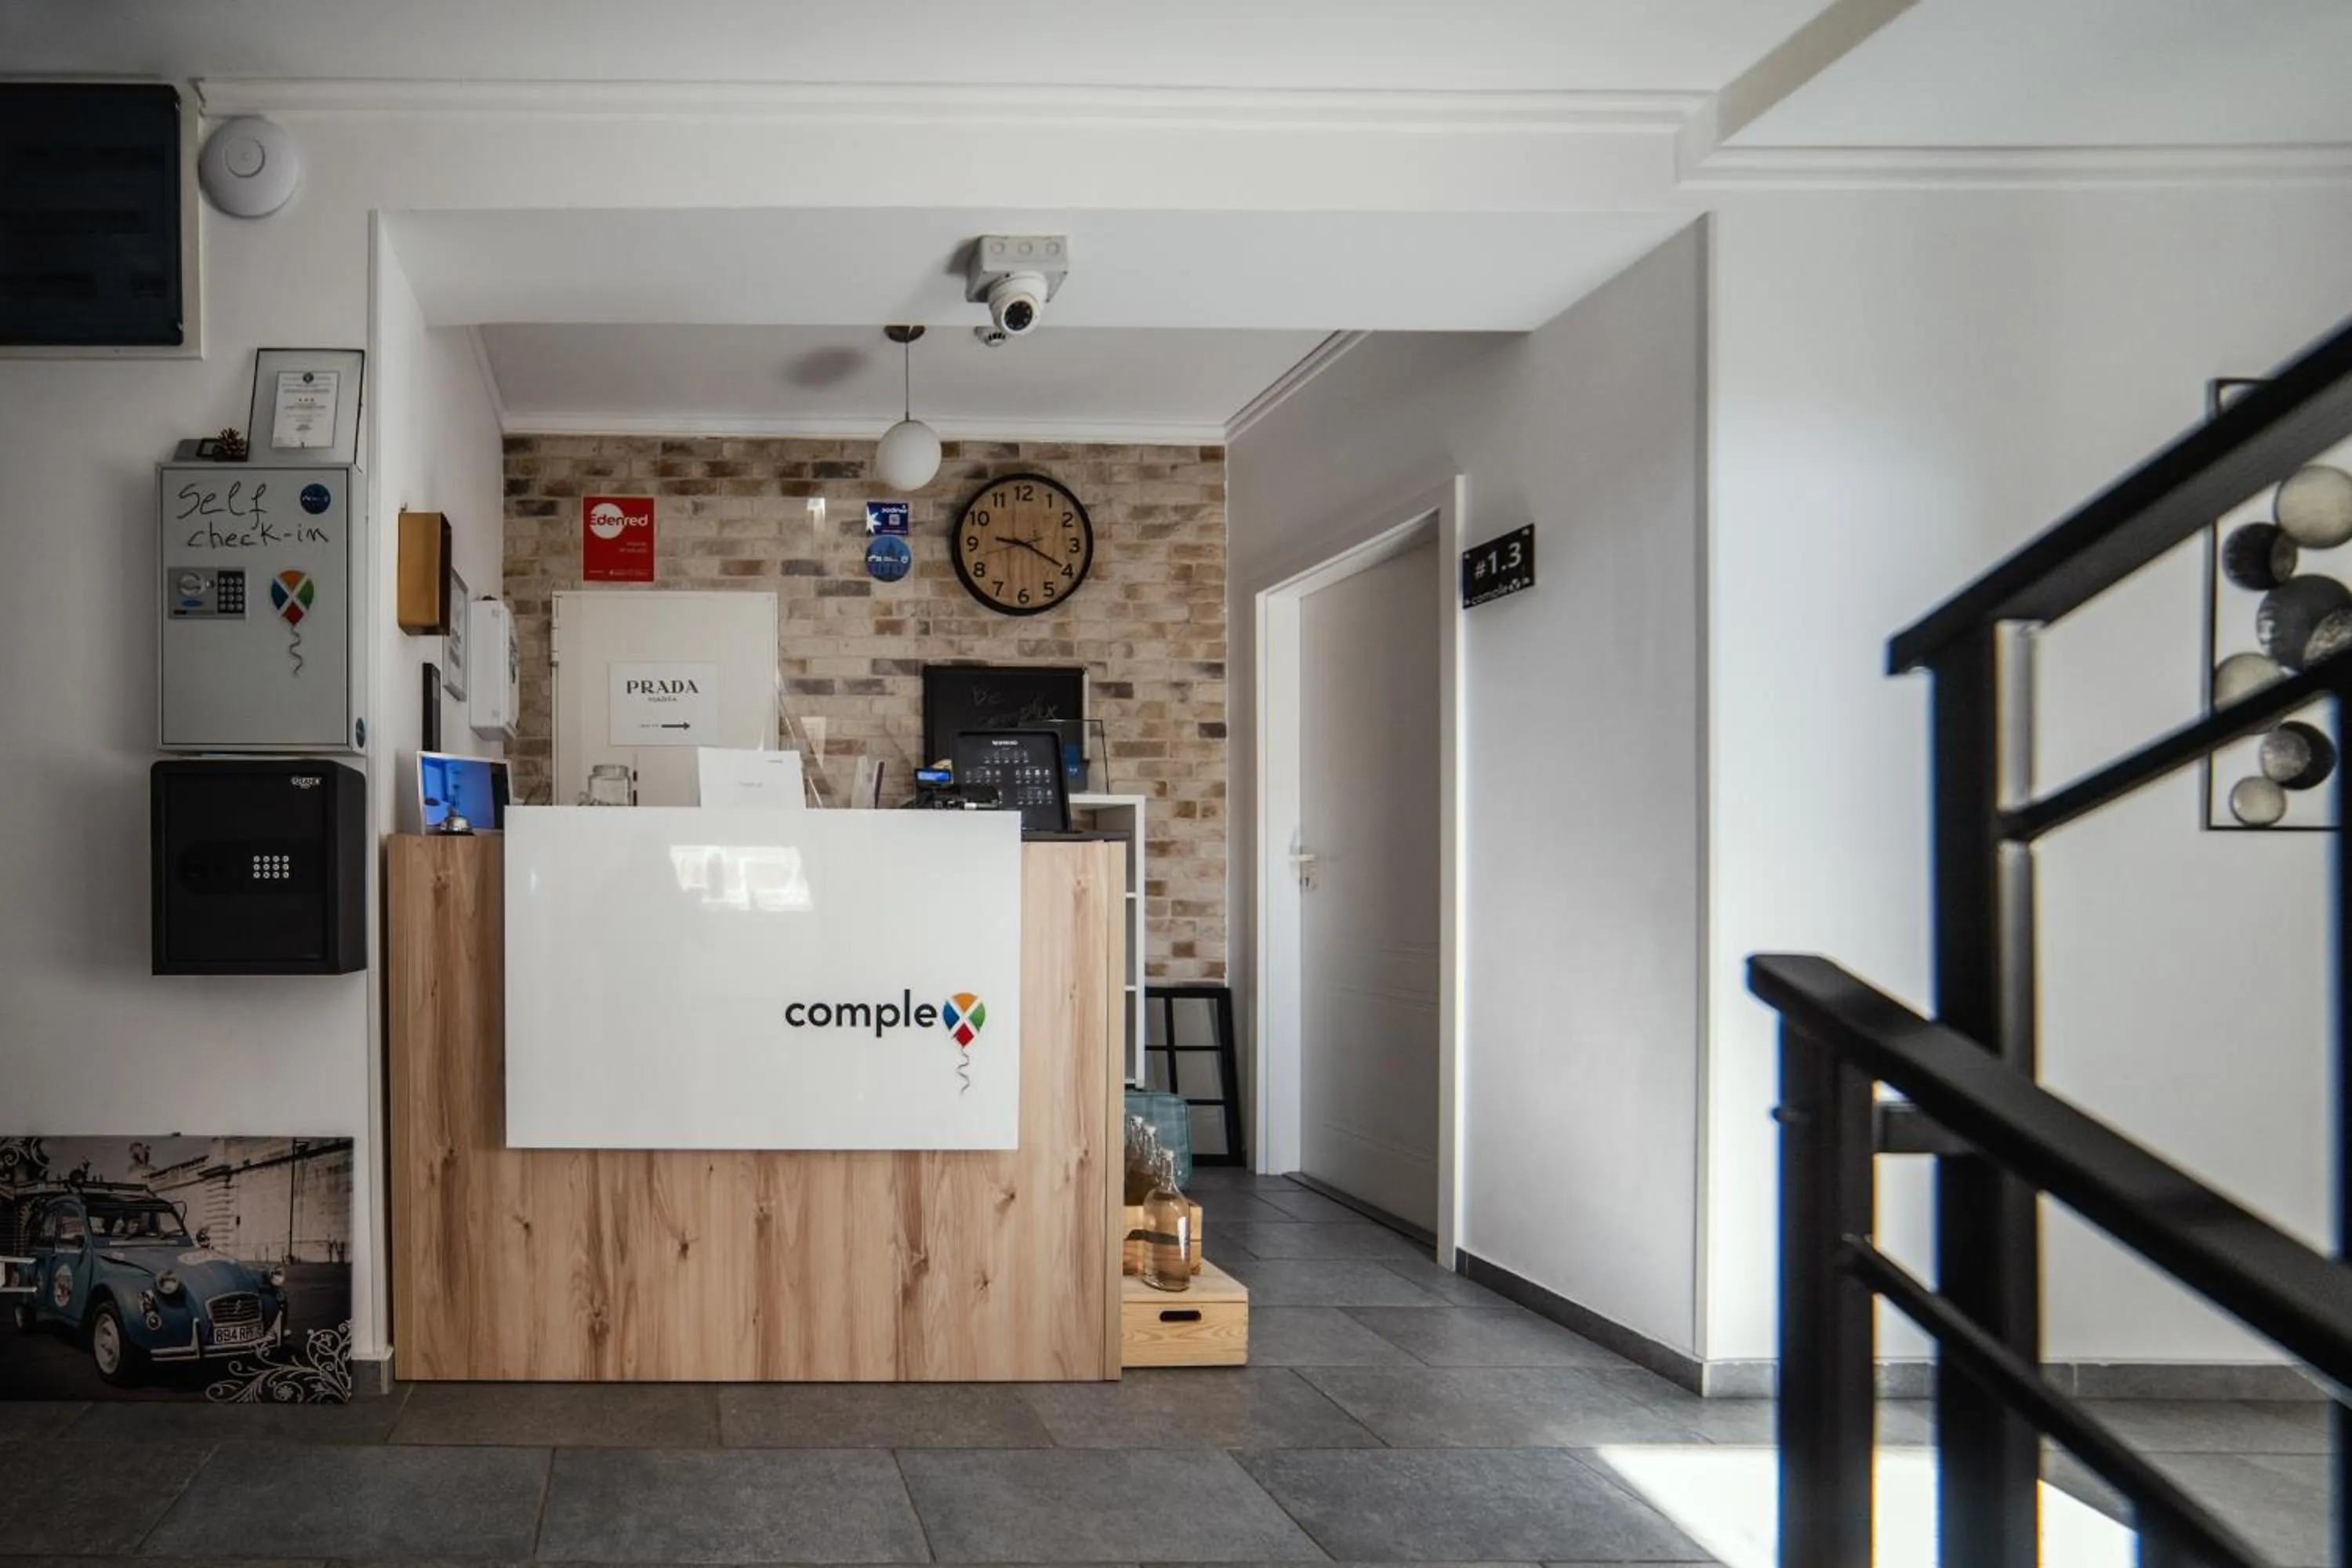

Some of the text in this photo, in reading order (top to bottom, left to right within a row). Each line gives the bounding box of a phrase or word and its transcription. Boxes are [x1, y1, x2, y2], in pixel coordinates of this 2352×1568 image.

[992, 492, 1006, 508] 11
[1014, 485, 1033, 502] 12
[1046, 493, 1053, 508] 1
[176, 481, 267, 530] Self
[590, 514, 648, 527] Edenred
[969, 510, 990, 527] 10
[1062, 511, 1073, 528] 2
[187, 521, 329, 549] check-in
[966, 535, 979, 552] 9
[1069, 537, 1080, 554] 3
[1475, 542, 1522, 579] #1.3
[973, 561, 985, 578] 8
[1061, 563, 1074, 579] 4
[993, 580, 1004, 597] 7
[1017, 589, 1029, 604] 6
[1043, 581, 1054, 597] 5
[626, 680, 699, 694] PRADA
